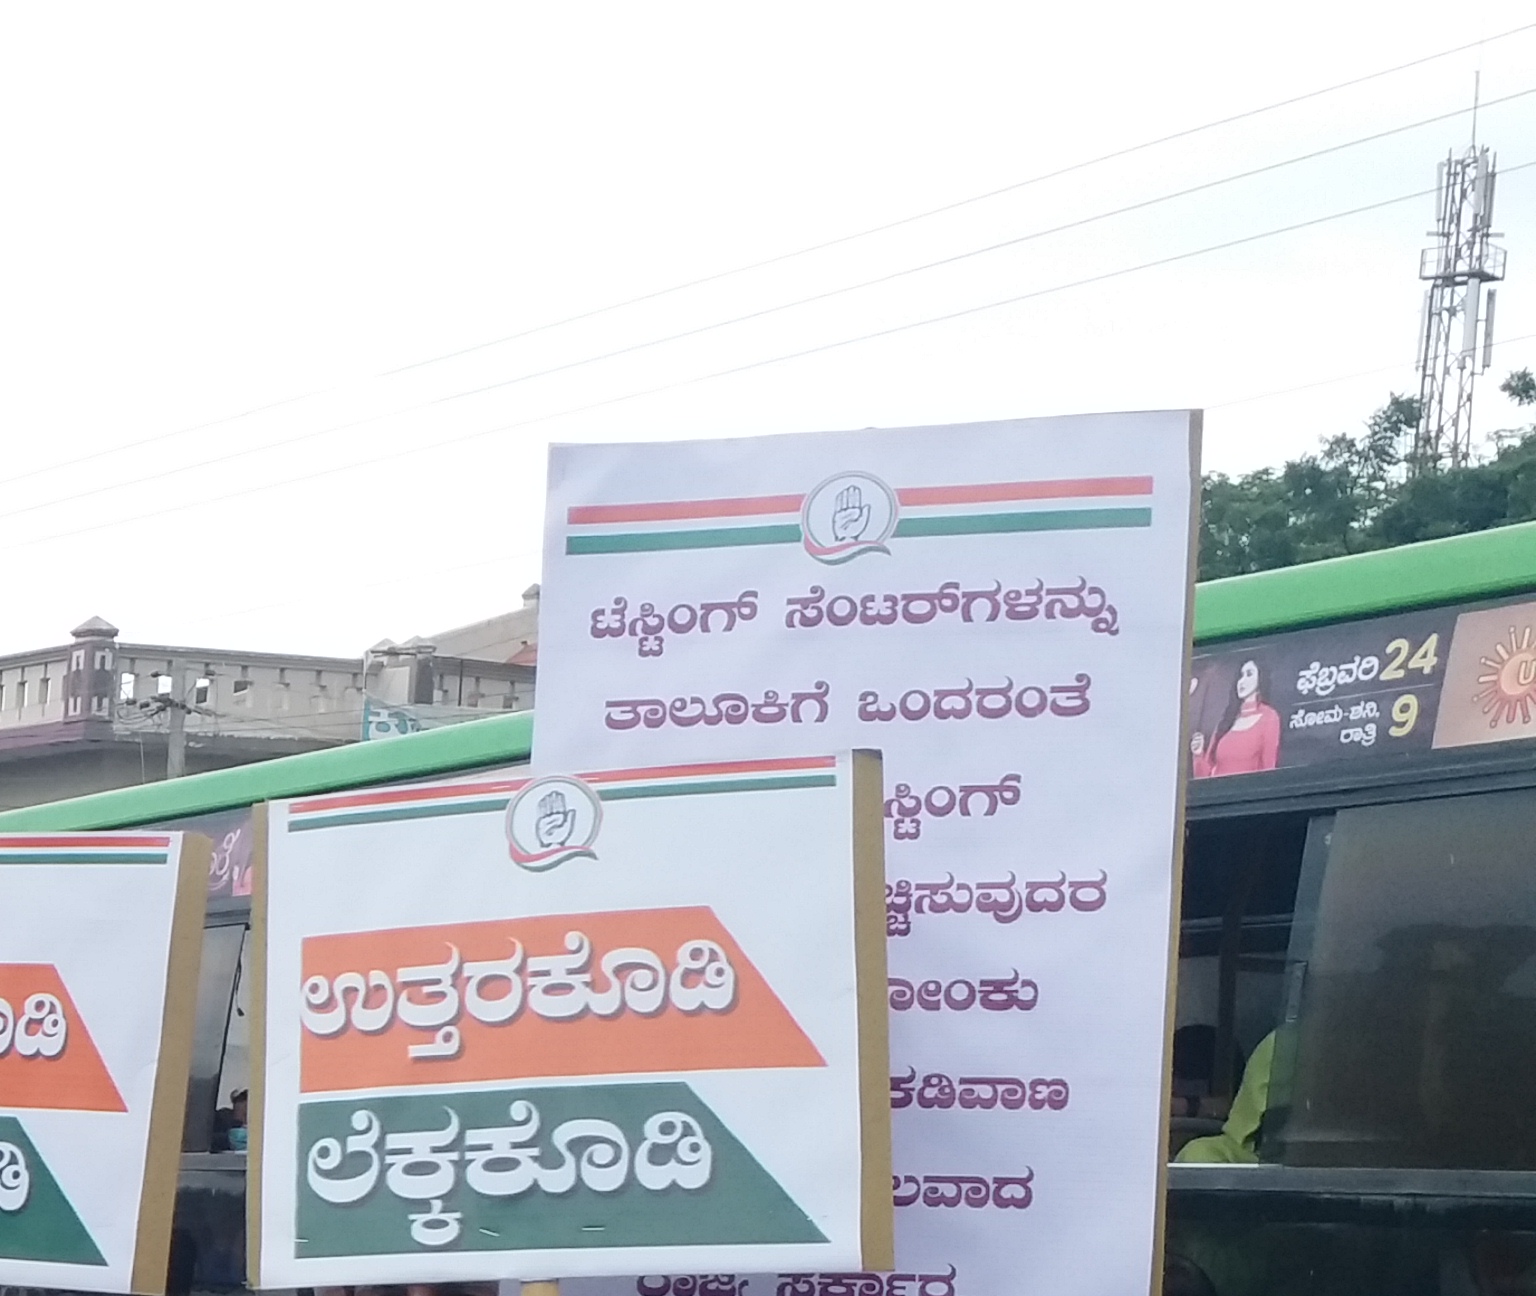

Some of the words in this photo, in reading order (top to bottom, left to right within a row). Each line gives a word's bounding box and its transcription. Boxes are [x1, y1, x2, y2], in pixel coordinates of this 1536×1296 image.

[590, 589, 759, 657] ಟೆಸ್ಟಿಂಗ್
[1379, 633, 1439, 681] 24
[605, 680, 831, 731] ತಾಲೂಕಿಗೆ
[858, 672, 1092, 723] ಒಂದರಂತೆ
[1389, 694, 1418, 737] 9
[884, 773, 1021, 840] ಸ್ಟಿಂಗ್
[300, 930, 737, 1060] ಉತ್ತರಕೊಡಿ
[307, 1100, 713, 1245] ಲೆಕ್ಕಕೊಡಿ
